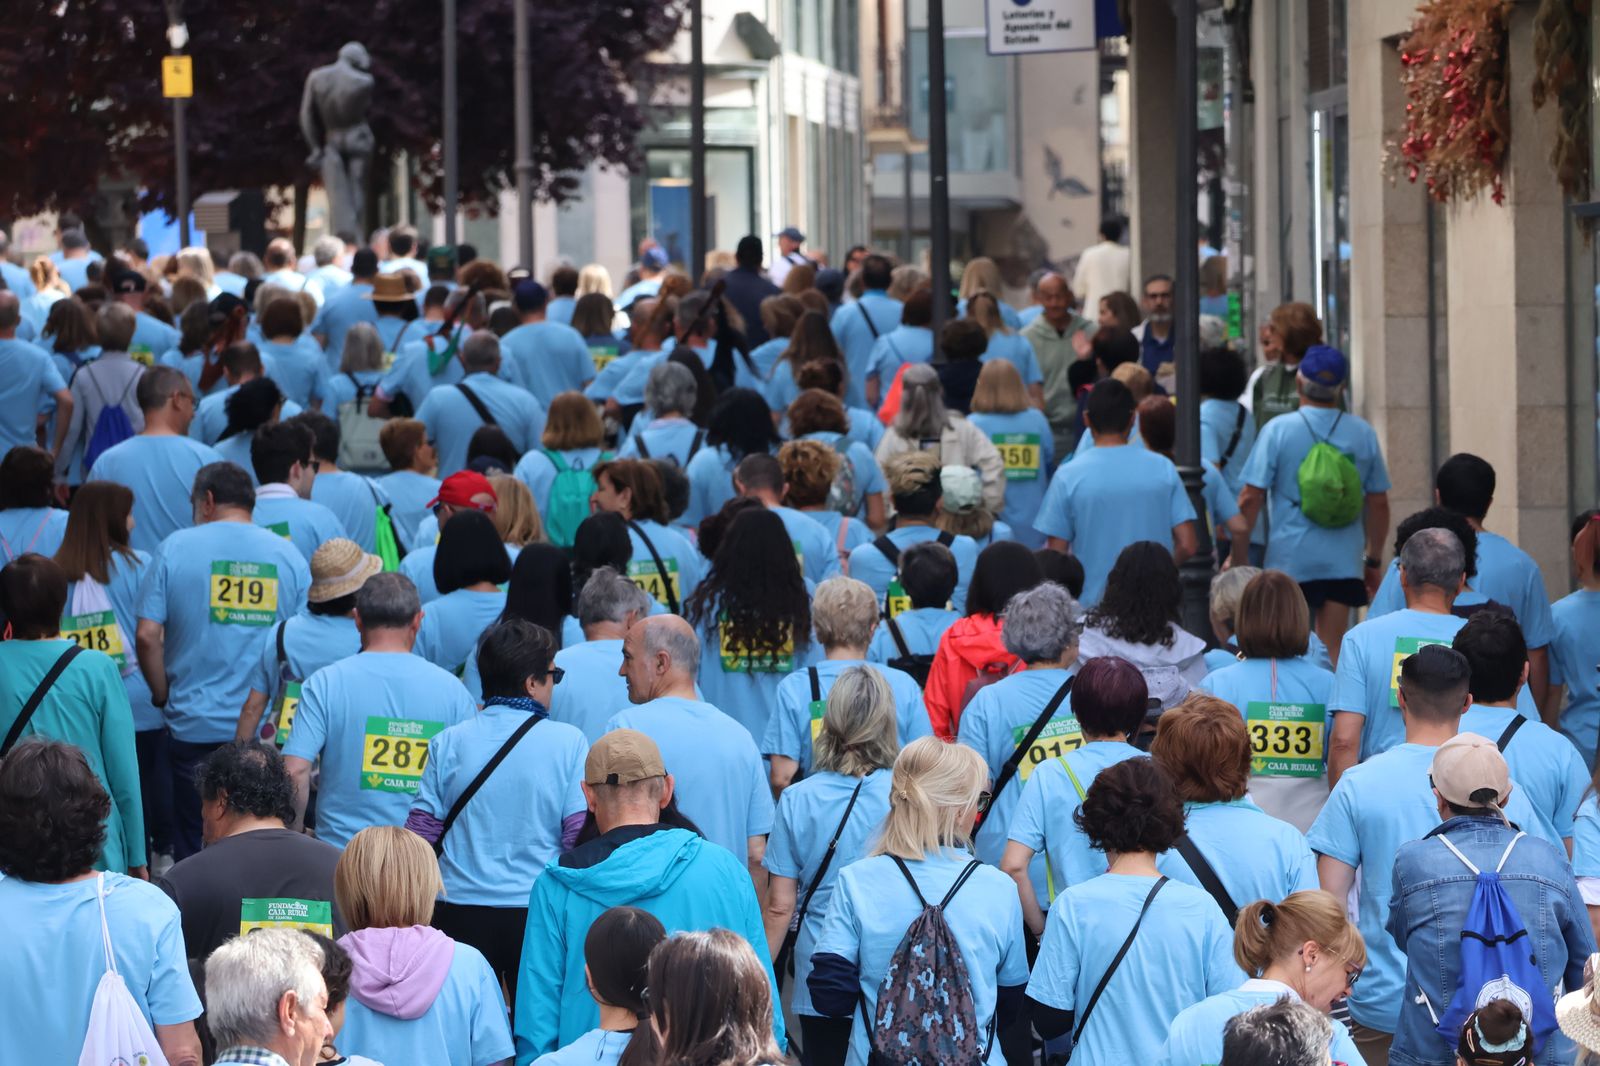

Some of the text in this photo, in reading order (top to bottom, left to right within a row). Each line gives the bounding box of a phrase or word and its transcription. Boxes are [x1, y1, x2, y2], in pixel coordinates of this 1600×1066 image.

[1056, 20, 1071, 30] del
[1004, 35, 1040, 45] Estado
[217, 578, 264, 605] 219
[1252, 725, 1311, 755] 333
[371, 738, 428, 770] 287
[1029, 738, 1083, 765] 017
[1268, 762, 1318, 772] CAJA RURAL
[384, 778, 405, 788] CAJA
[268, 908, 309, 917] CAJA RURAL
